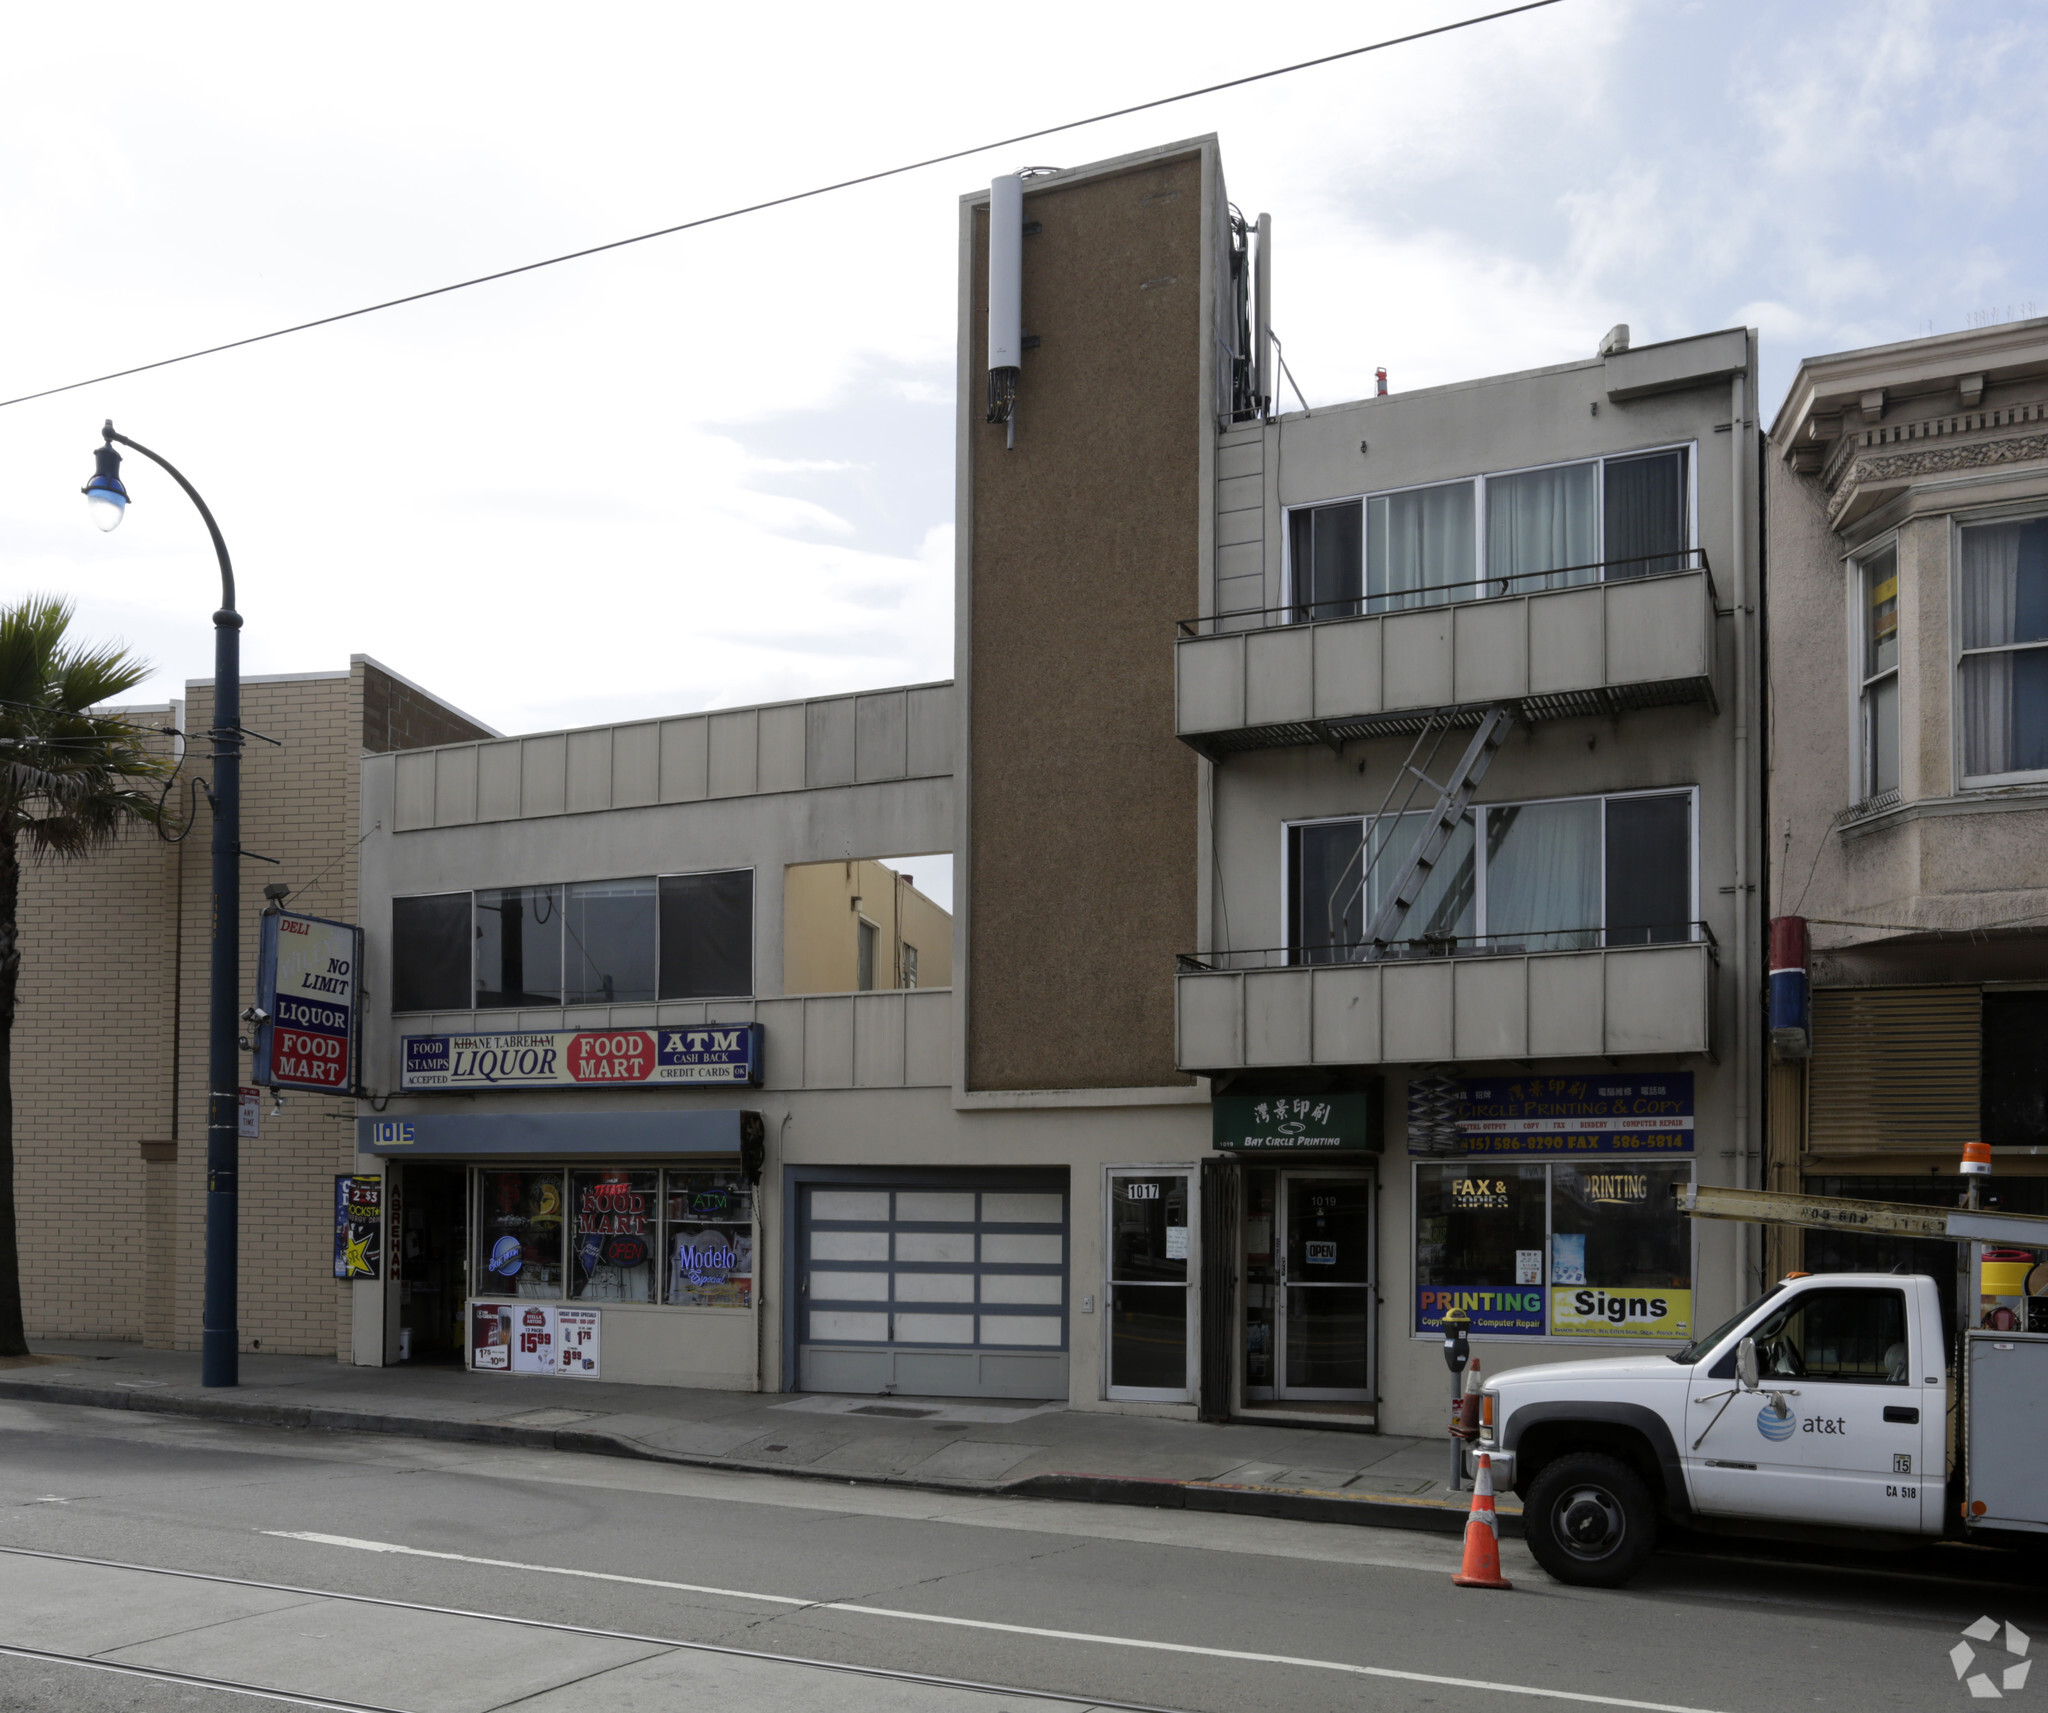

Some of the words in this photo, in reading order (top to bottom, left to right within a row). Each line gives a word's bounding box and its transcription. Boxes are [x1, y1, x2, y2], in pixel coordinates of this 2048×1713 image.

[280, 920, 310, 935] DELI
[327, 958, 350, 976] NO
[302, 973, 348, 995] LIMIT
[279, 1002, 346, 1028] LIQUOR
[282, 1033, 340, 1058] FOOD
[413, 1042, 443, 1054] FOOD
[454, 1036, 492, 1049] KIDANE
[580, 1036, 644, 1057] FOOD
[663, 1031, 742, 1052] ATM
[408, 1058, 450, 1070] STAMPS
[452, 1048, 556, 1082] LIQUOR
[674, 1054, 698, 1064] CASH
[704, 1052, 729, 1062] BACK
[278, 1056, 340, 1081] MART
[578, 1058, 644, 1078] MART
[660, 1068, 696, 1078] CREDIT
[698, 1067, 730, 1077] CARDS
[734, 1067, 746, 1076] OK
[408, 1076, 448, 1084] ACCEPTED
[244, 1109, 254, 1118] ANY
[1524, 1102, 1608, 1116] PRINTING
[1612, 1099, 1629, 1114] &
[1632, 1098, 1684, 1114] COPY
[243, 1118, 254, 1126] TIME
[1483, 1122, 1507, 1130] OUTPUT
[1622, 1120, 1658, 1128] COMPUTER
[374, 1122, 415, 1144] 1015
[1244, 1136, 1264, 1146] BAY
[1266, 1136, 1294, 1146] CIRCLE
[1296, 1136, 1341, 1146] PRINTING
[1494, 1136, 1564, 1150] 586-8290
[1568, 1136, 1600, 1149] FAX
[1612, 1134, 1683, 1148] 586-5814
[1130, 1184, 1158, 1198] 1017
[1452, 1180, 1490, 1196] FAX
[1495, 1180, 1507, 1194] &
[1584, 1174, 1648, 1199] PRINTING
[353, 1190, 360, 1202] 2
[365, 1191, 378, 1202] $3
[581, 1193, 646, 1214] FOOD
[694, 1194, 728, 1208] ATM
[1312, 1196, 1336, 1206] 1019
[1452, 1195, 1508, 1208] COPIES
[391, 1184, 401, 1280] ABREHAM
[578, 1214, 648, 1235] MART
[608, 1243, 642, 1260] OPEN
[680, 1245, 736, 1270] Modelo
[1310, 1244, 1334, 1257] OPEN
[688, 1268, 726, 1286] Especial
[1420, 1292, 1542, 1312] PRINTING
[1574, 1290, 1668, 1322] Signs
[1478, 1318, 1514, 1328] Computer
[1516, 1319, 1540, 1328] Repair
[520, 1332, 551, 1353] 1599
[563, 1350, 582, 1366] 999
[1802, 1416, 1846, 1435] at&t
[1896, 1460, 1909, 1472] 15
[1886, 1486, 1898, 1498] CA
[1901, 1487, 1916, 1499] 518
